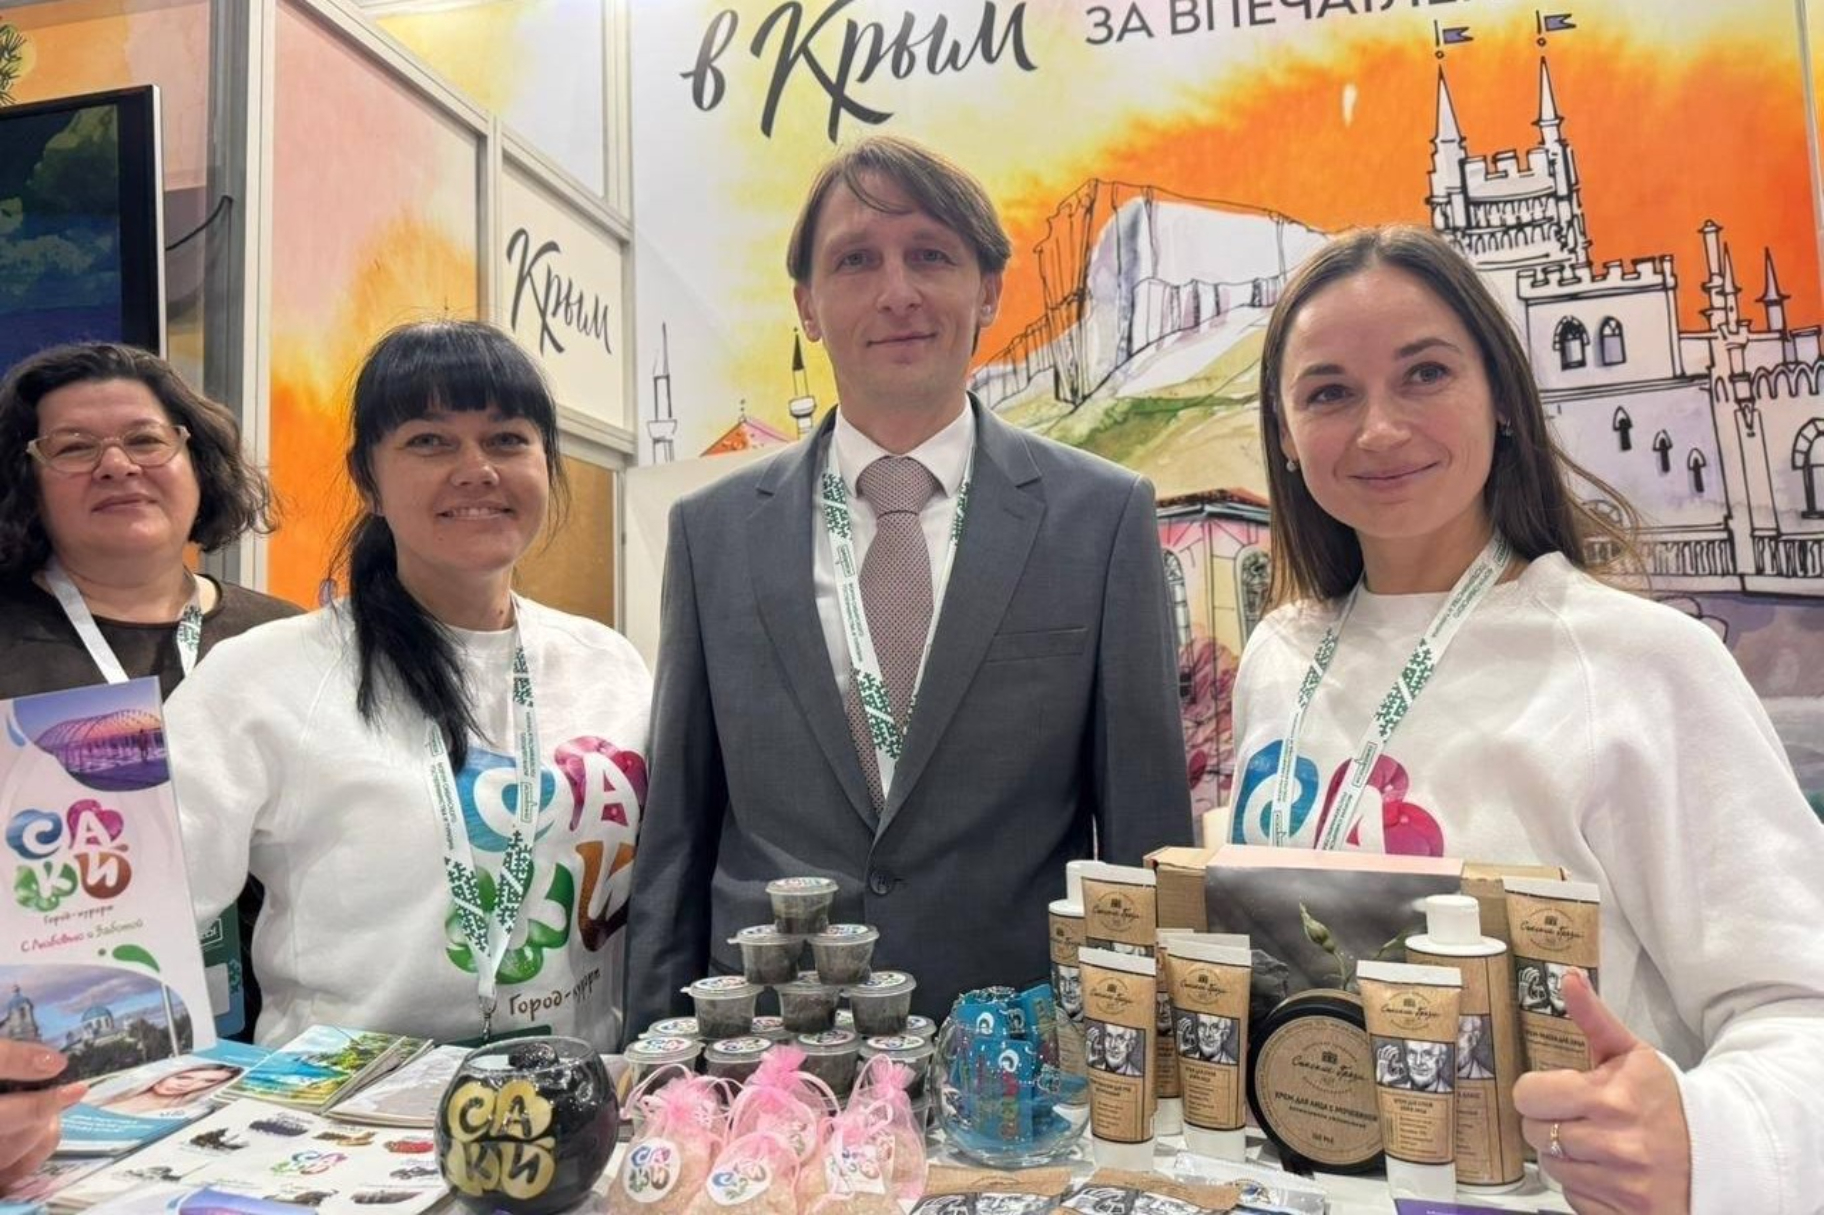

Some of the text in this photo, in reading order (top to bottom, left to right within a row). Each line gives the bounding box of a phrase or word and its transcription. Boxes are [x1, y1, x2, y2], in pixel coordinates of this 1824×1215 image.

[679, 0, 1452, 144] в Крым ЗА ВПЕЧ
[506, 227, 612, 357] Крым
